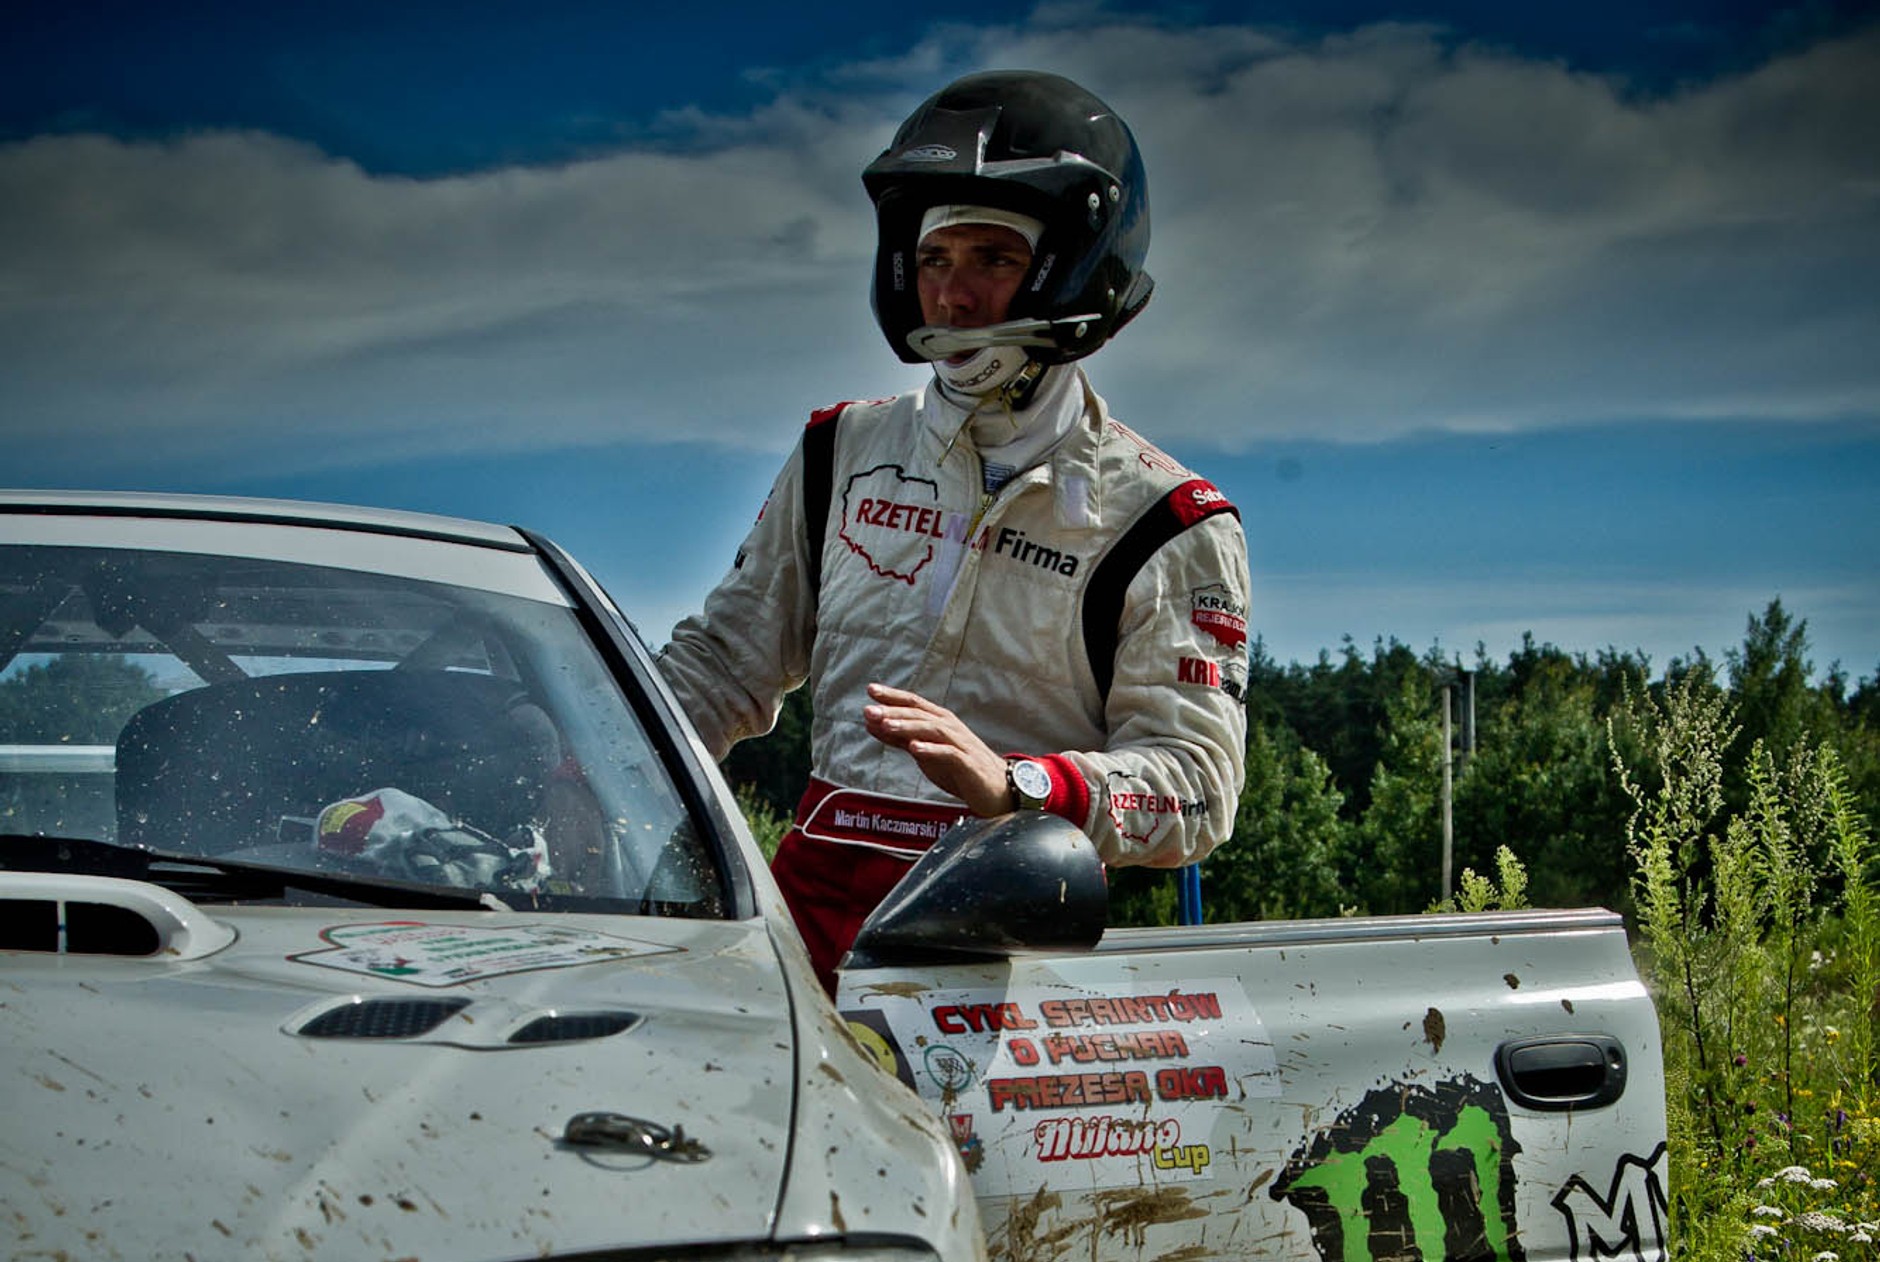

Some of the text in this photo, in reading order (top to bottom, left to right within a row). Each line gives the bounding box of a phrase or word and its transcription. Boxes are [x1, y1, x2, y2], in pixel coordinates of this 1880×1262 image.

[995, 526, 1079, 578] Firma
[834, 809, 870, 829] Martin
[871, 813, 938, 839] Kaczmarski
[932, 989, 1222, 1035] CYKL SPRINTÓW
[1009, 1030, 1190, 1066] O PUCHAR
[988, 1071, 1150, 1113] PREZESA
[1034, 1115, 1180, 1162] Milano
